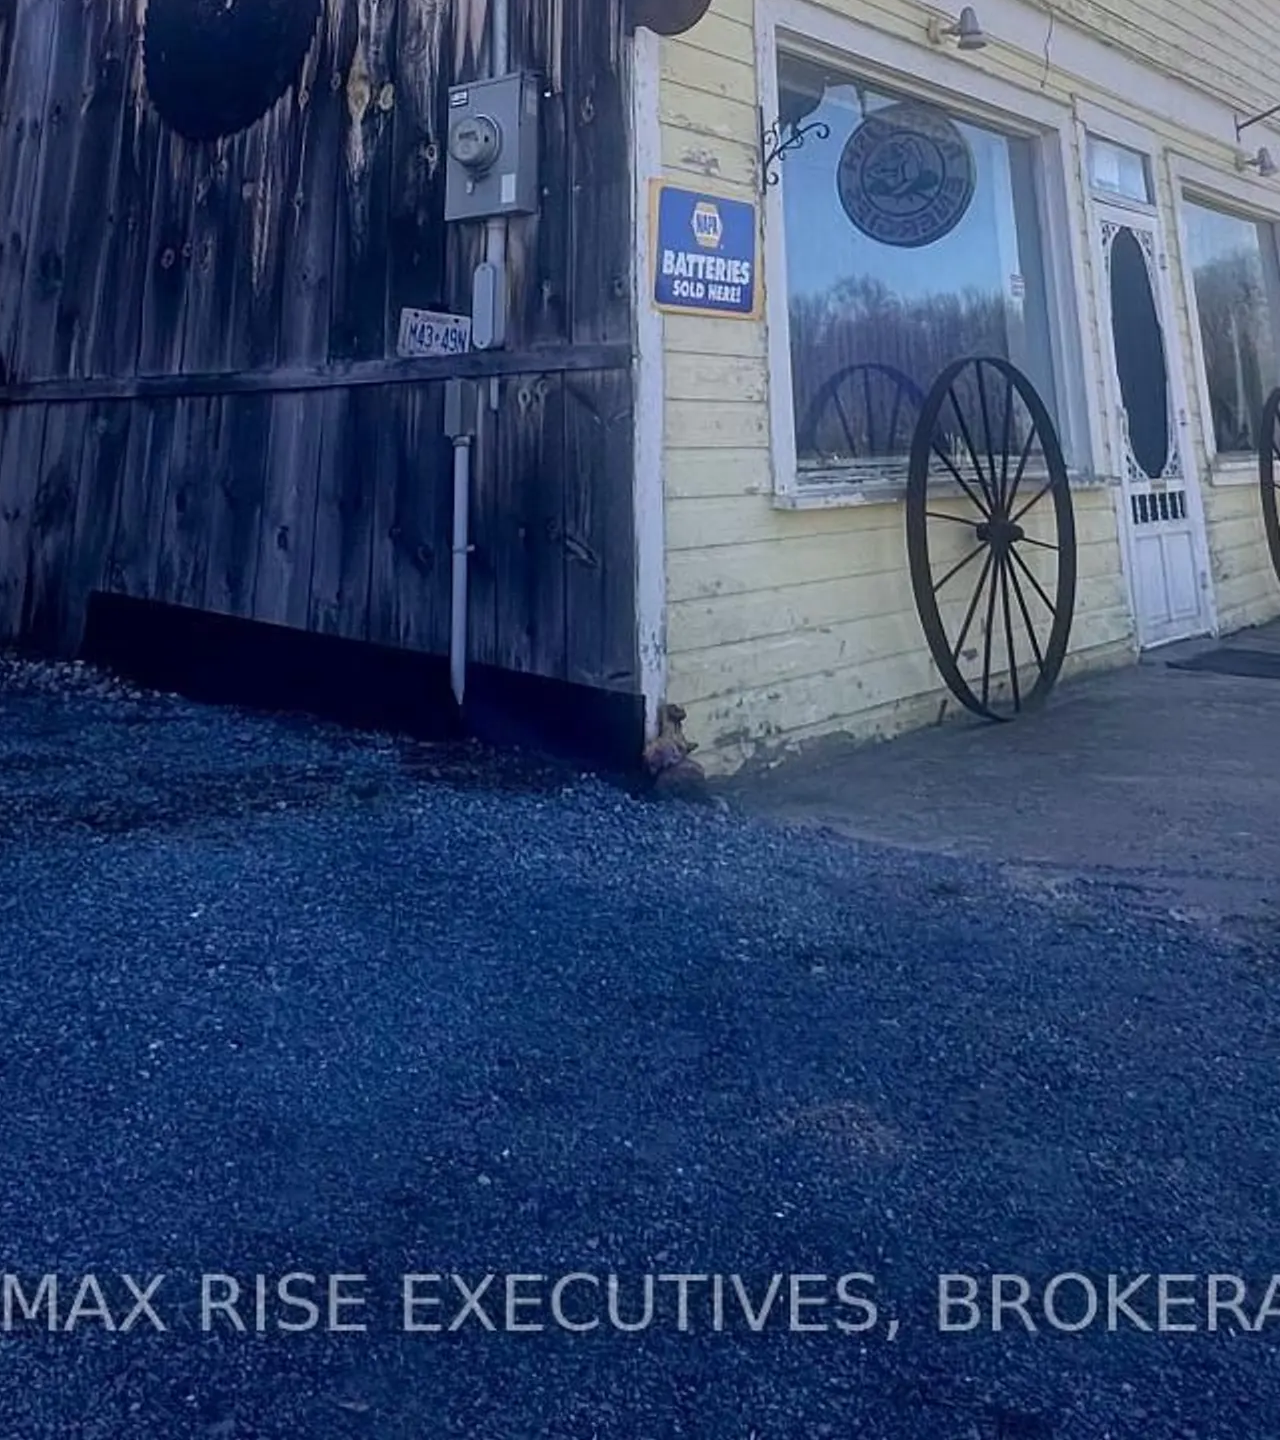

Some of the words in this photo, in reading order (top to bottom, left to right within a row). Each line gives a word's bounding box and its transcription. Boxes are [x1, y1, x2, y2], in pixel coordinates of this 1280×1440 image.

[662, 249, 751, 285] BATTERIES
[672, 280, 705, 299] SOLD
[708, 283, 742, 303] HERE!
